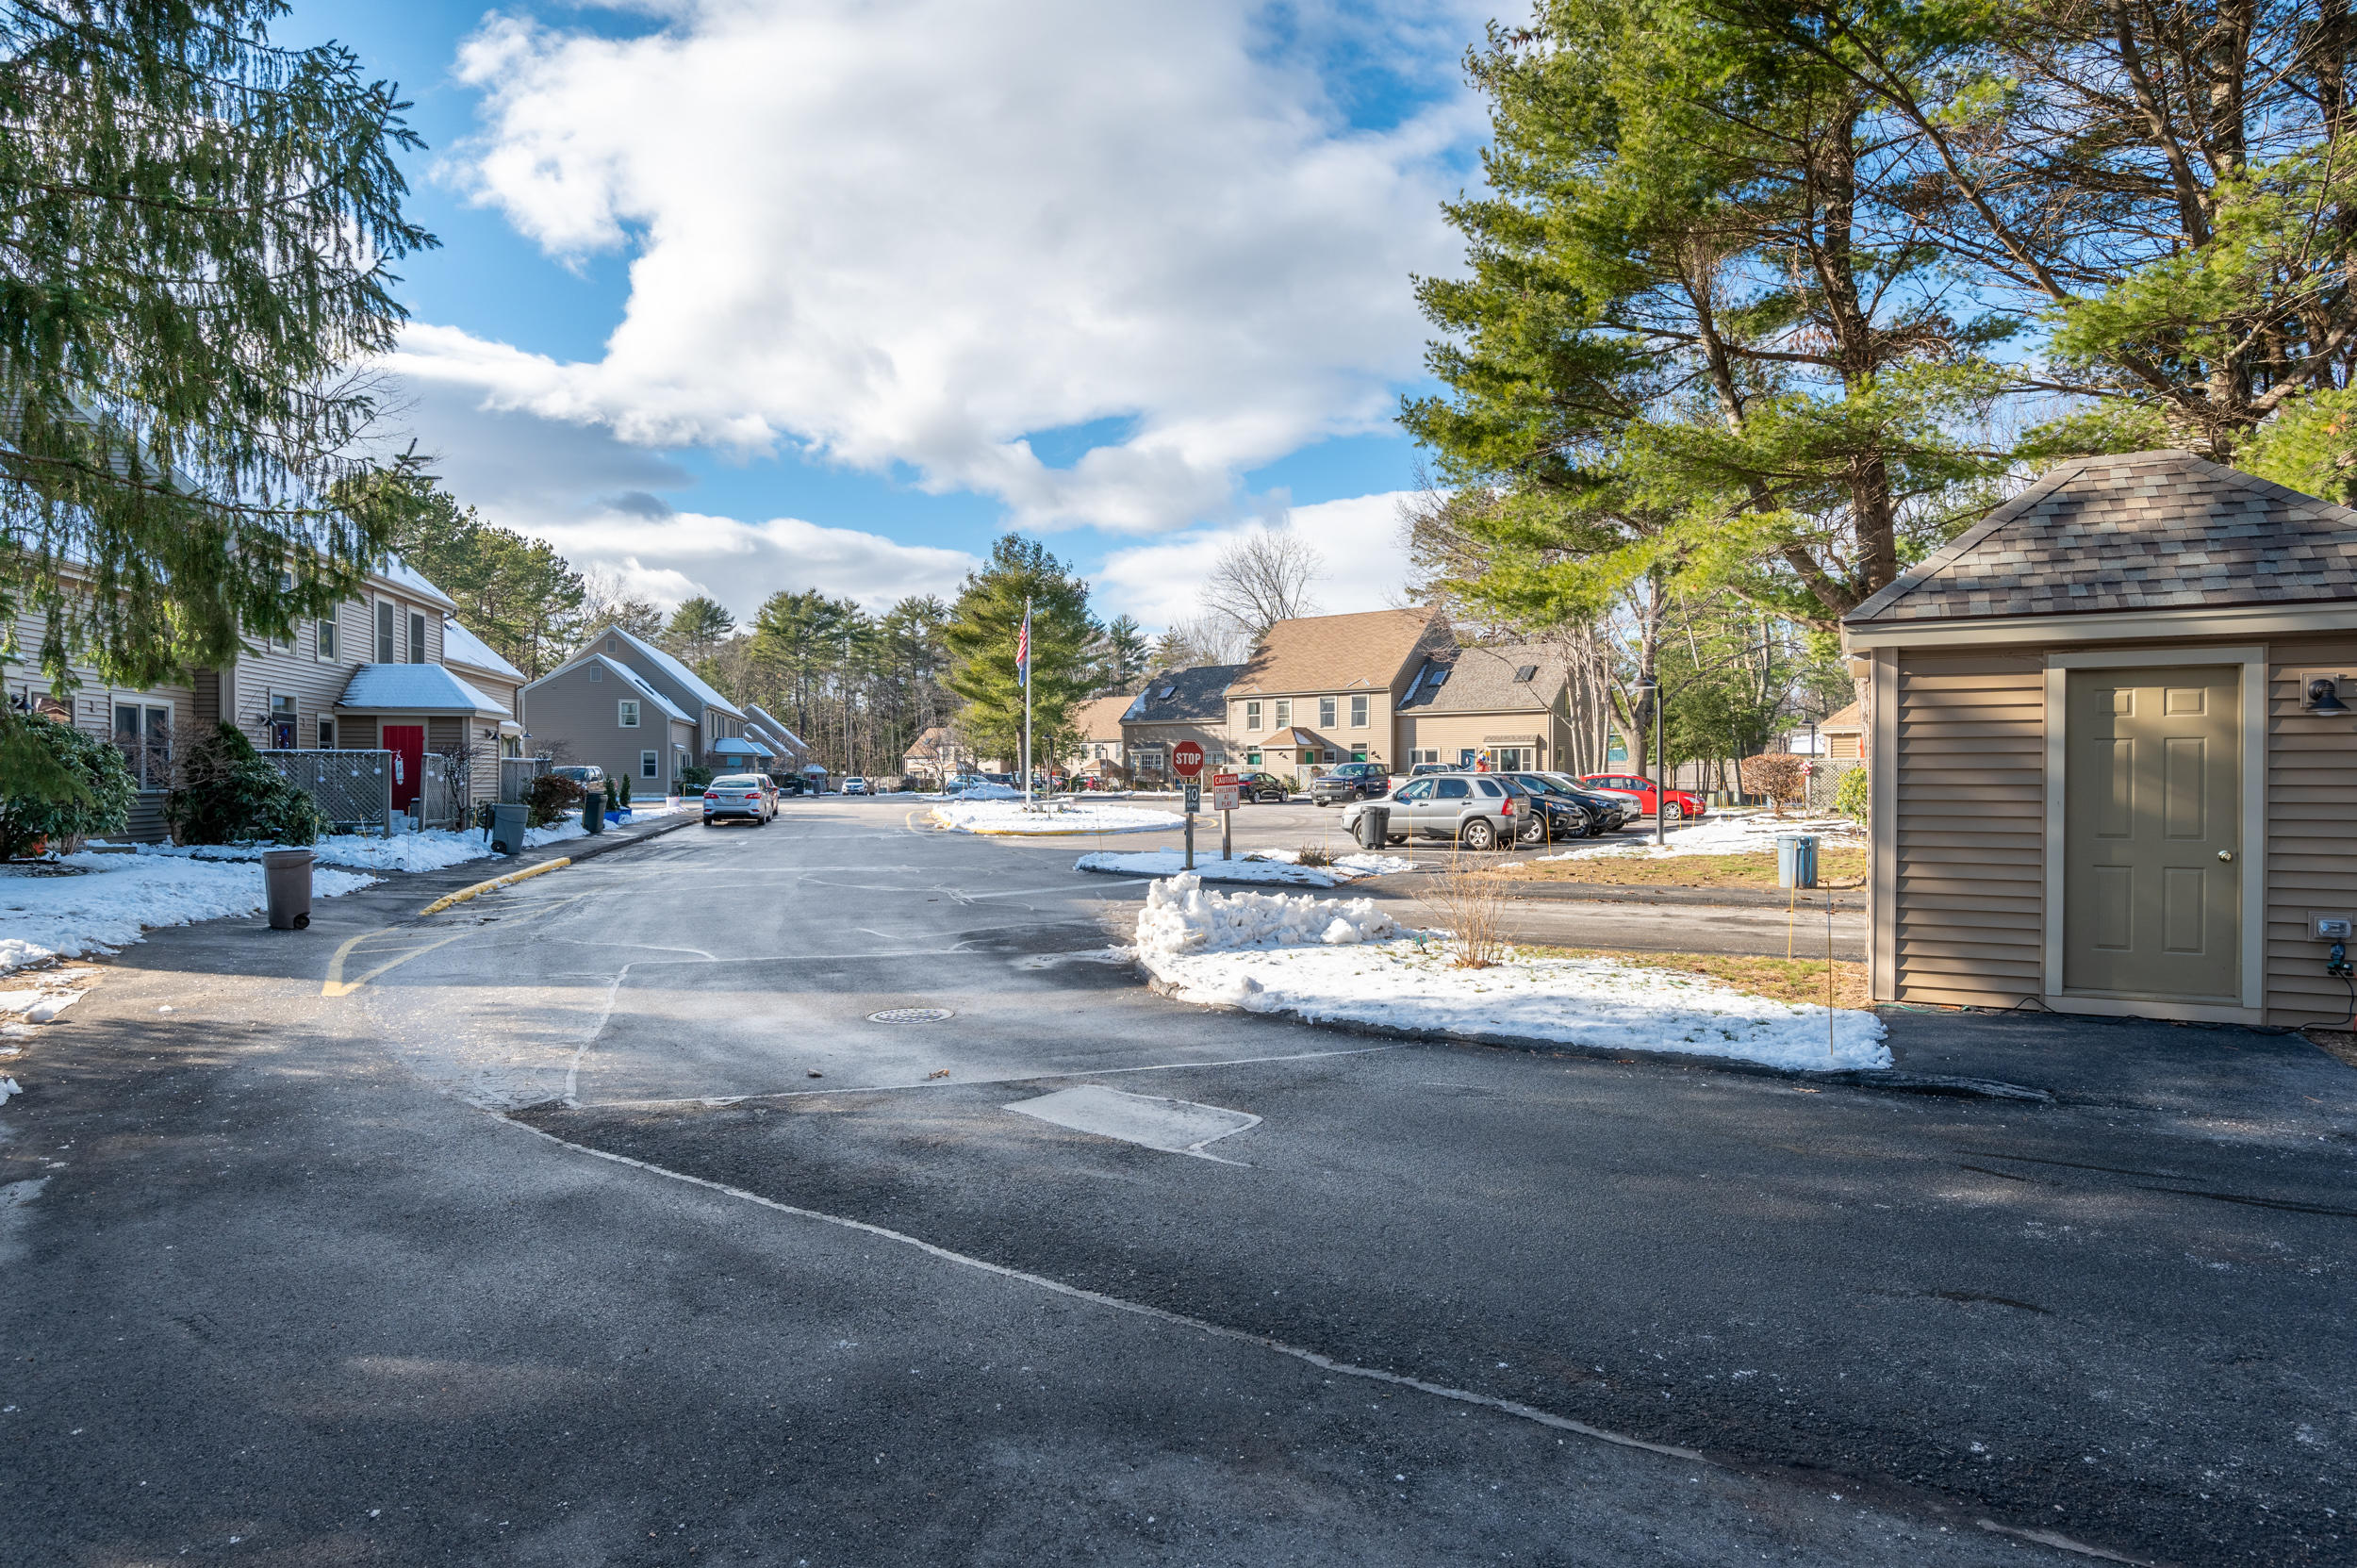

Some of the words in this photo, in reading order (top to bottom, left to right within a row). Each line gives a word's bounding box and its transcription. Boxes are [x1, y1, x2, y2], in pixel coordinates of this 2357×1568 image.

[1176, 752, 1201, 765] STOP
[1215, 776, 1237, 784] CAUTION
[1187, 789, 1198, 801] 10
